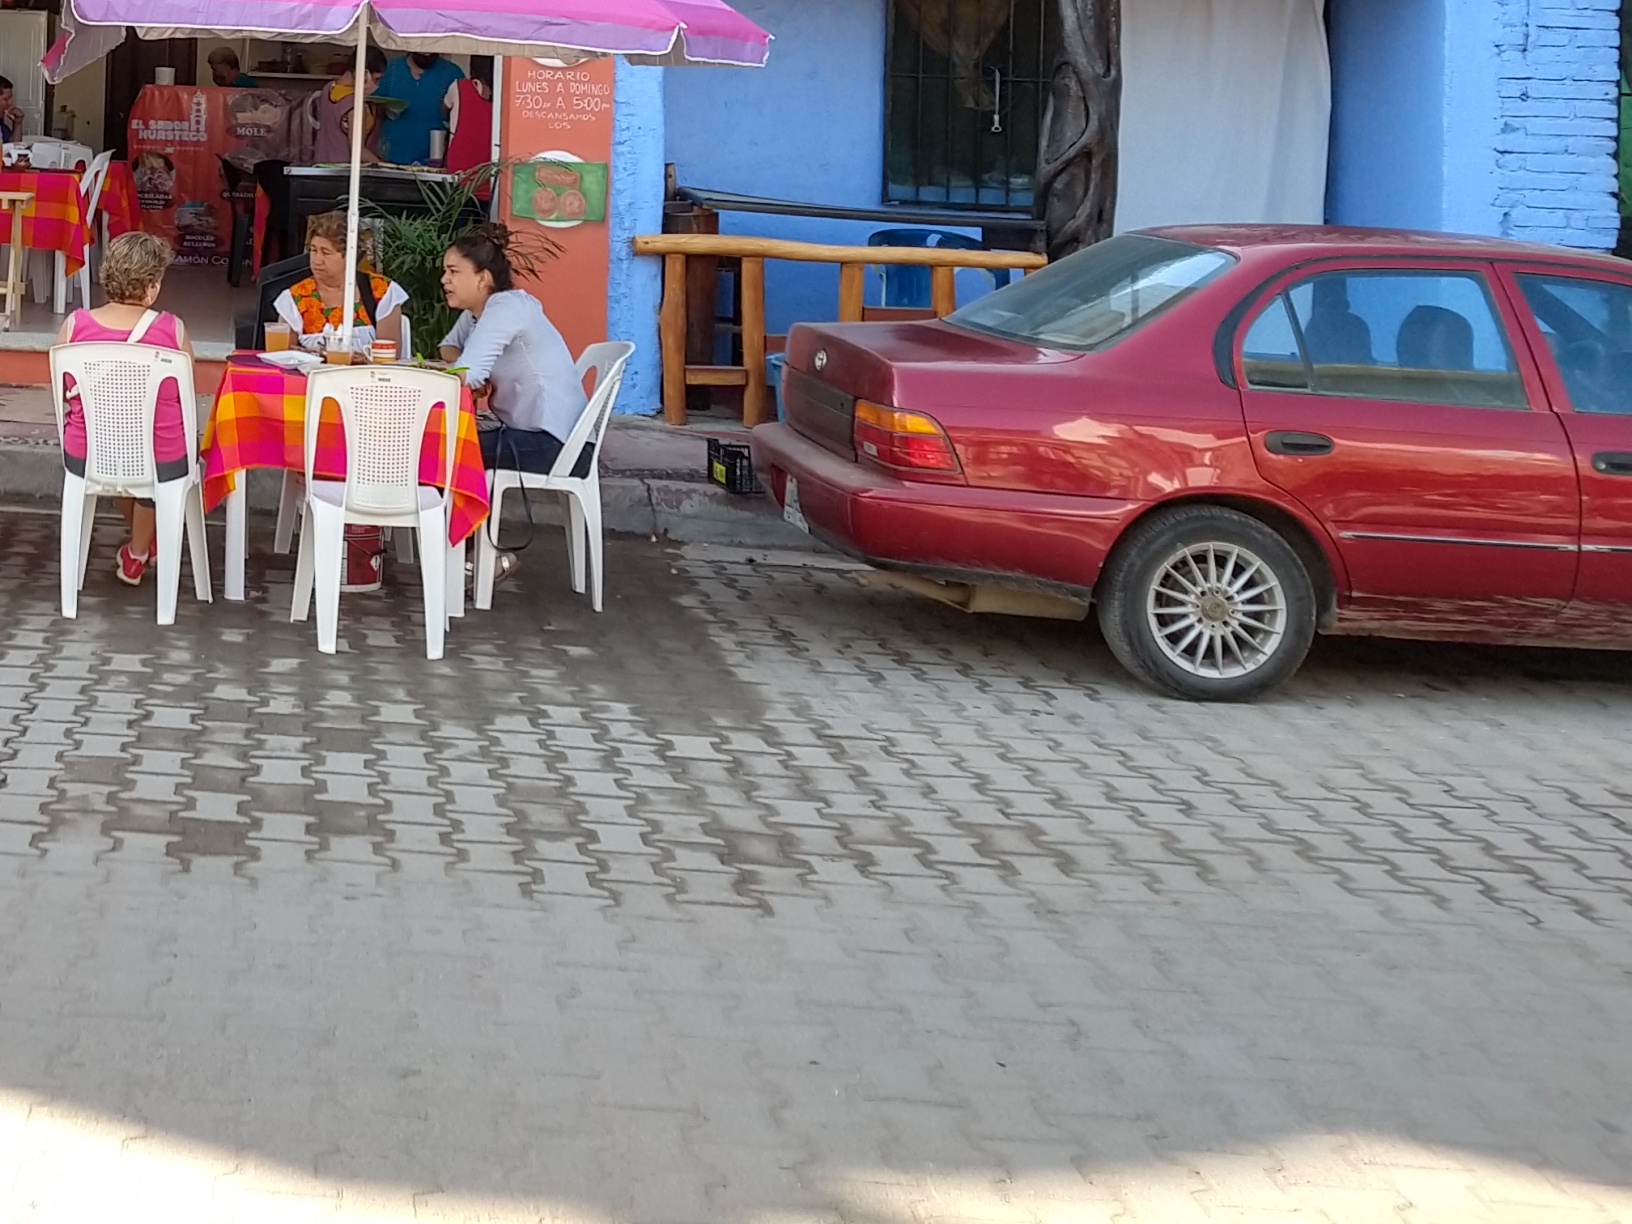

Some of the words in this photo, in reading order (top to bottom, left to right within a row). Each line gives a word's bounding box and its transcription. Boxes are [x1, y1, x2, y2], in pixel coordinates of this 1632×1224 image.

[528, 70, 590, 82] HORARIO
[515, 81, 549, 93] LUNES
[556, 82, 565, 94] A
[570, 82, 610, 95] DOMINGO
[556, 97, 566, 109] A
[522, 110, 596, 122] DESCANSAMOS
[131, 119, 145, 129] EL
[149, 120, 189, 131] SABOR
[138, 129, 207, 142] HUASTECO
[236, 127, 268, 137] MOLE
